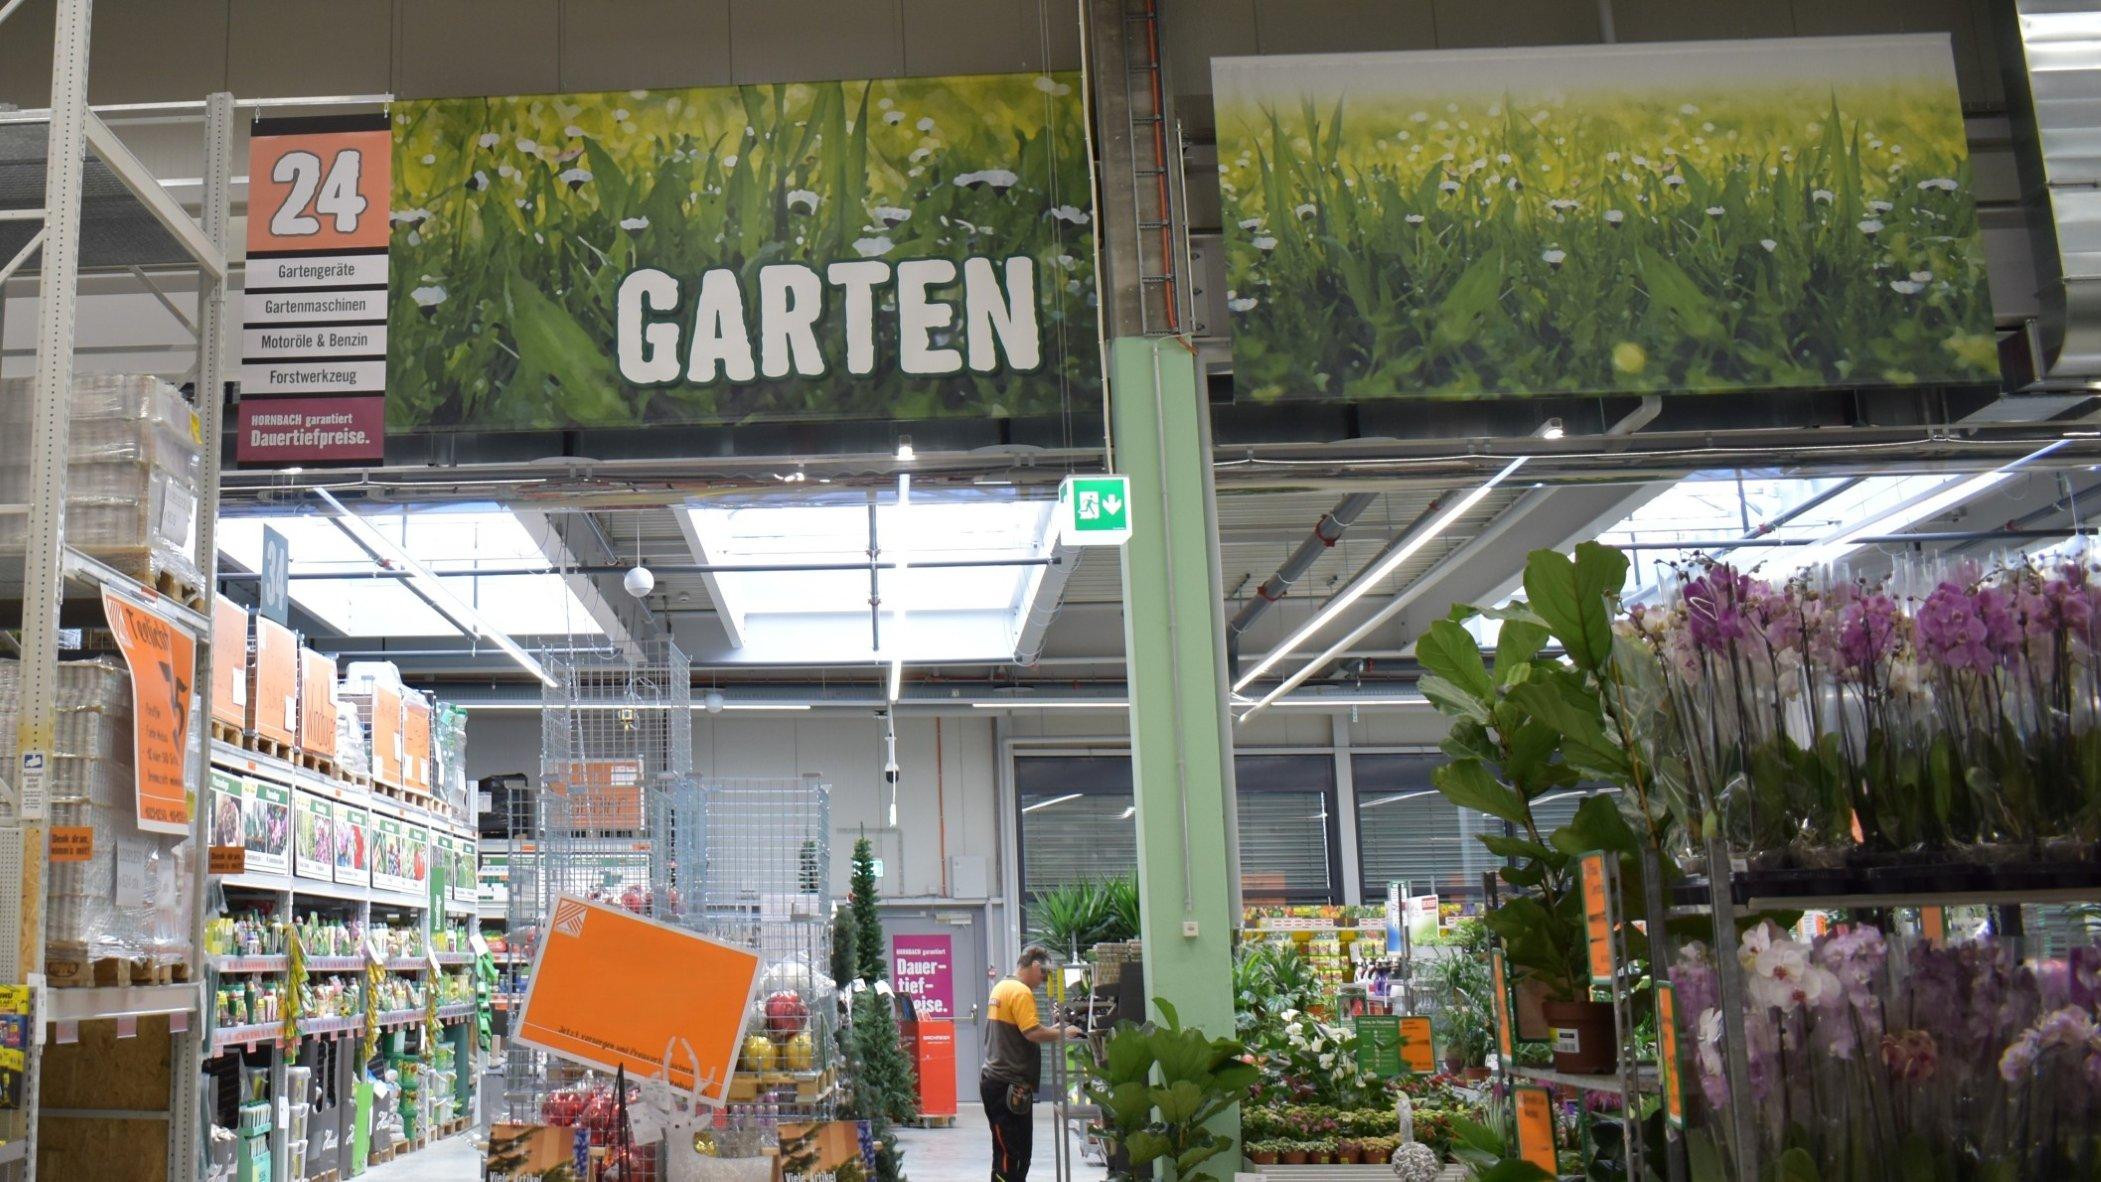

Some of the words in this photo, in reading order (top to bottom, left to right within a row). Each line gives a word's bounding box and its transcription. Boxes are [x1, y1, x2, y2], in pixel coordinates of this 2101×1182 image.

[270, 148, 369, 237] 24
[278, 263, 356, 280] Gartengeräte
[265, 297, 367, 315] Gartenmaschinen
[616, 255, 1041, 385] GARTEN
[261, 334, 313, 350] Motoröle
[316, 334, 326, 348] &
[329, 332, 369, 348] Benzin
[269, 369, 358, 386] Forstwerkzeug
[250, 414, 302, 428] HORNBACH
[305, 413, 353, 429] garantiert
[250, 428, 371, 449] Dauertiefpreise.
[266, 540, 285, 611] 34
[897, 958, 947, 975] Dauer-
[898, 977, 934, 994] tief-
